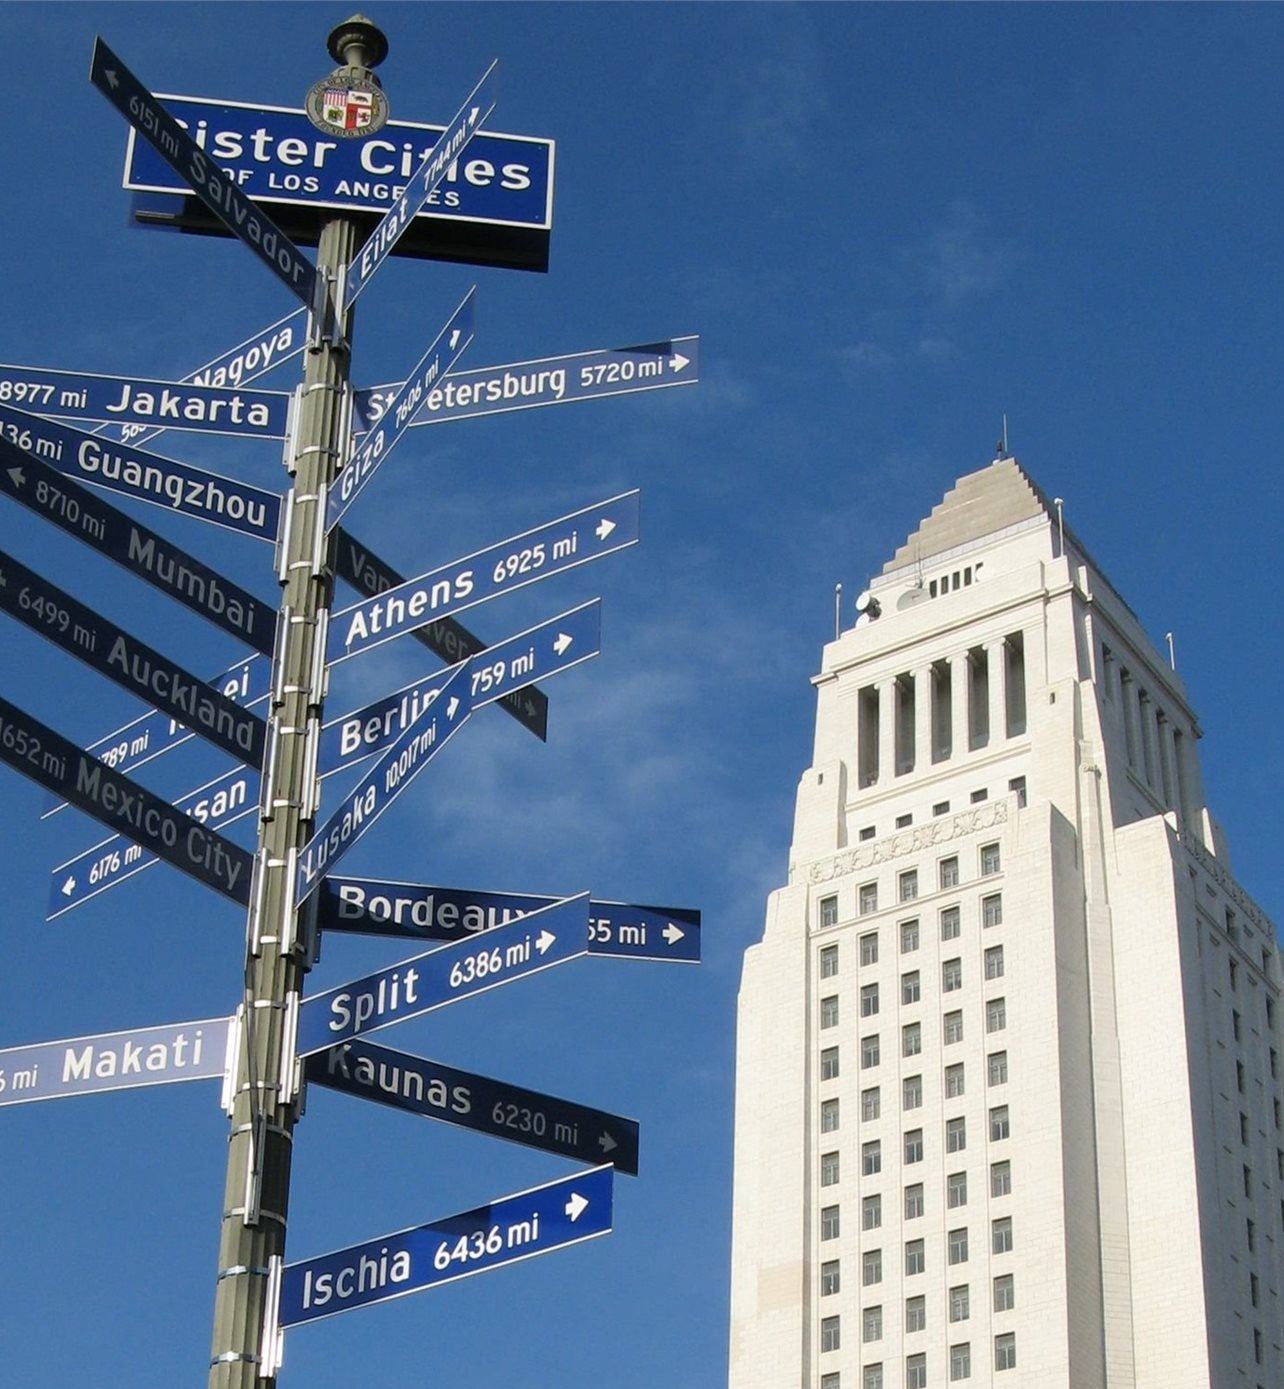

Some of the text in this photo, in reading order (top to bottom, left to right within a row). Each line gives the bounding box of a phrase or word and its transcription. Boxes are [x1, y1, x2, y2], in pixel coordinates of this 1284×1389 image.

[129, 95, 305, 283] 6151 mi Salvador
[174, 117, 338, 168] ister
[268, 172, 319, 192] LOS
[334, 180, 460, 207] ANGEES
[360, 195, 408, 279] Eilat
[452, 119, 466, 152] mi
[0, 380, 270, 426] 8977 mi Jakarta
[341, 429, 385, 501] Giza
[425, 353, 439, 388] mi
[427, 367, 566, 411] etersburg
[580, 361, 634, 387] 5720
[638, 355, 663, 379] mi
[36, 438, 63, 460] mi
[77, 439, 266, 527] Guangzhou
[35, 481, 256, 635] 8710 mi Mumbai
[345, 530, 578, 646] Athens 6925 mi
[18, 587, 71, 632] 6499
[74, 623, 97, 652] mi
[108, 636, 254, 752] Auckland
[511, 647, 534, 679] mi
[130, 729, 149, 757] mi
[42, 751, 67, 781] mi
[76, 756, 177, 847] Mexico
[187, 830, 243, 891] City
[306, 784, 376, 884] Lusaka
[420, 717, 437, 755] mi
[89, 844, 142, 885] 6176 mi
[619, 922, 646, 945] mi
[328, 934, 531, 1033] Split 6386 mi
[12, 1064, 38, 1090] mi
[62, 1030, 203, 1083] Makati
[328, 1043, 579, 1147] Kaunas 6230 mi
[302, 1212, 539, 1310] Ischia 6436 mi
